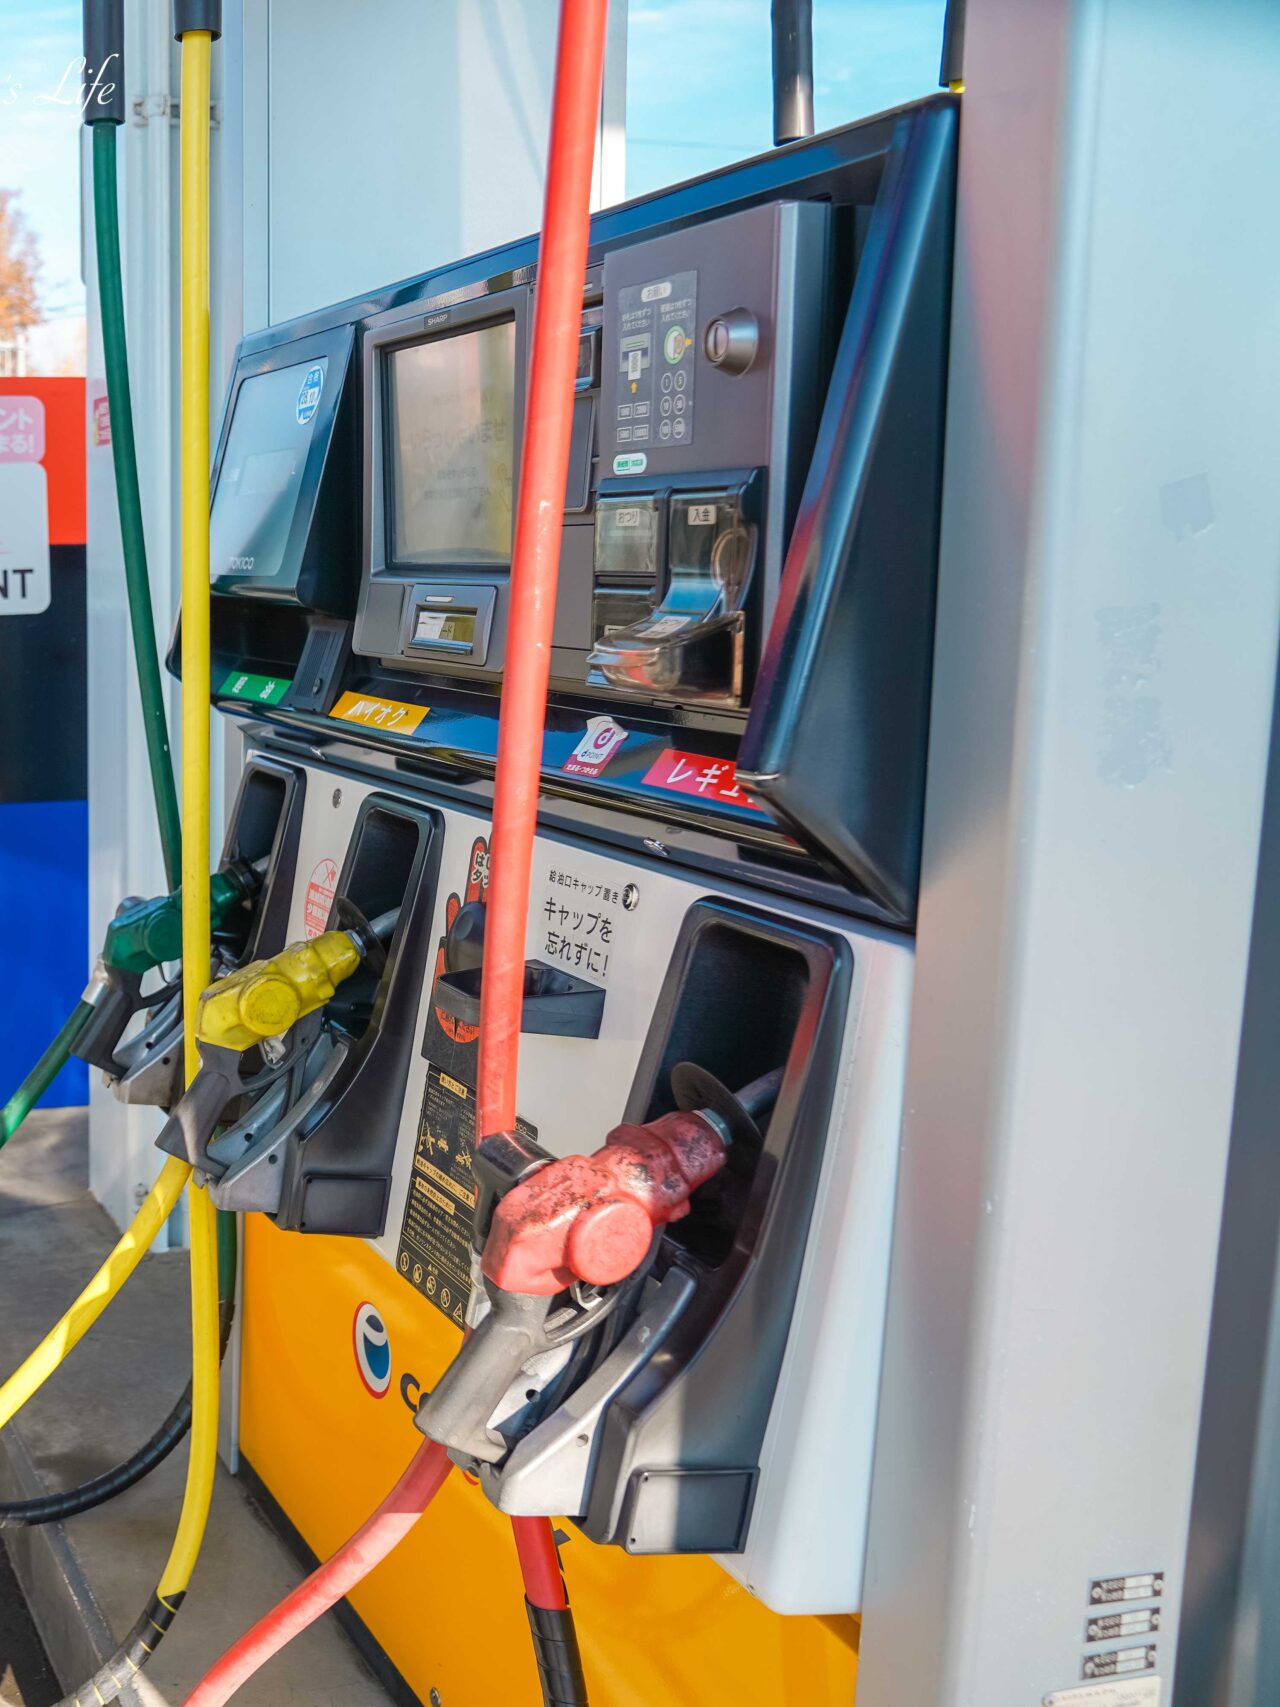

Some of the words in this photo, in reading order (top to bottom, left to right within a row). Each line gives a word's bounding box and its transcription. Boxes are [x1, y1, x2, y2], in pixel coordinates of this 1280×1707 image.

[427, 314, 448, 326] SHARP
[618, 511, 639, 524] おつり
[693, 507, 711, 522] 入金
[229, 557, 255, 570] TOKICO
[549, 869, 620, 905] 給油口キャップ置き
[544, 896, 614, 944] キャップを
[545, 930, 610, 977] 忘れずに!
